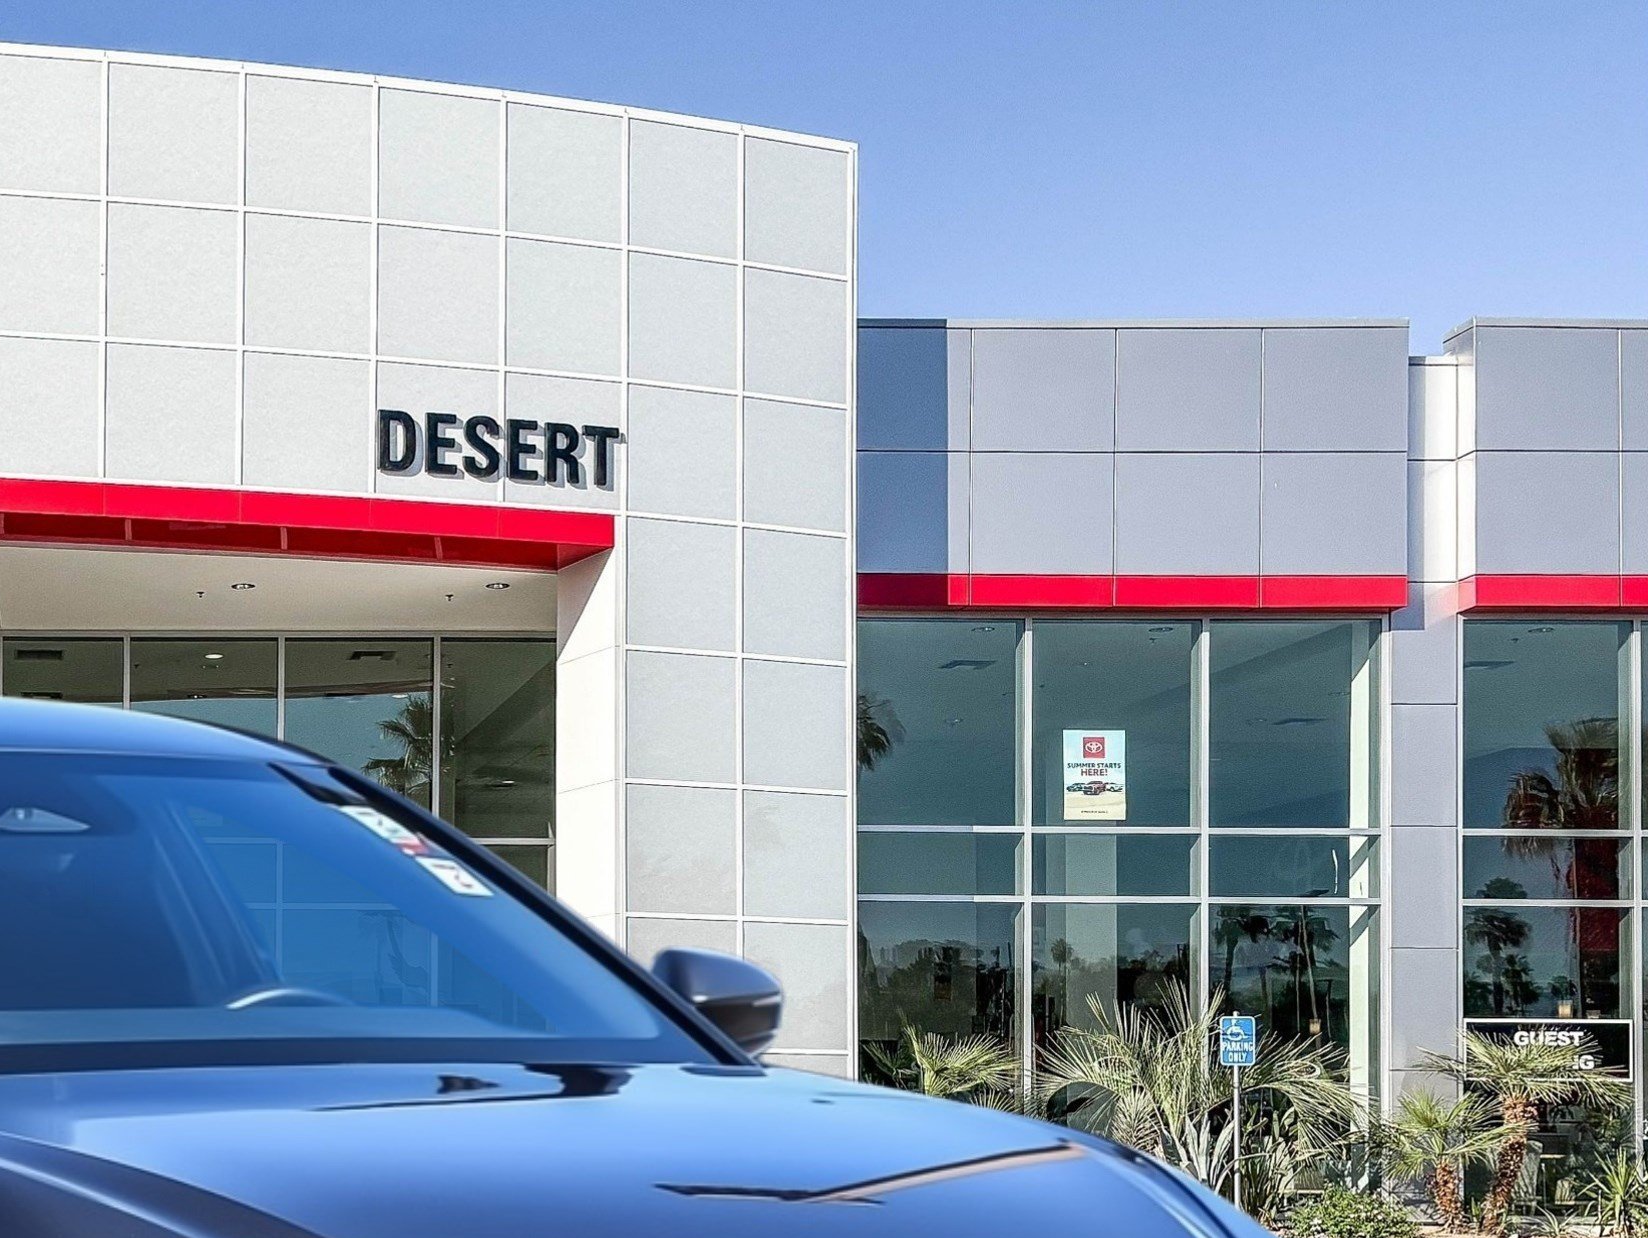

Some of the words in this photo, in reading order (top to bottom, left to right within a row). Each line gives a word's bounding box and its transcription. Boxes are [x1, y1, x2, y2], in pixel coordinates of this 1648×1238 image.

[377, 409, 620, 487] DESERT
[1080, 768, 1108, 777] HERE!
[1513, 1030, 1584, 1047] GUEST
[1222, 1041, 1254, 1052] PARKING
[1228, 1051, 1248, 1063] ONLY
